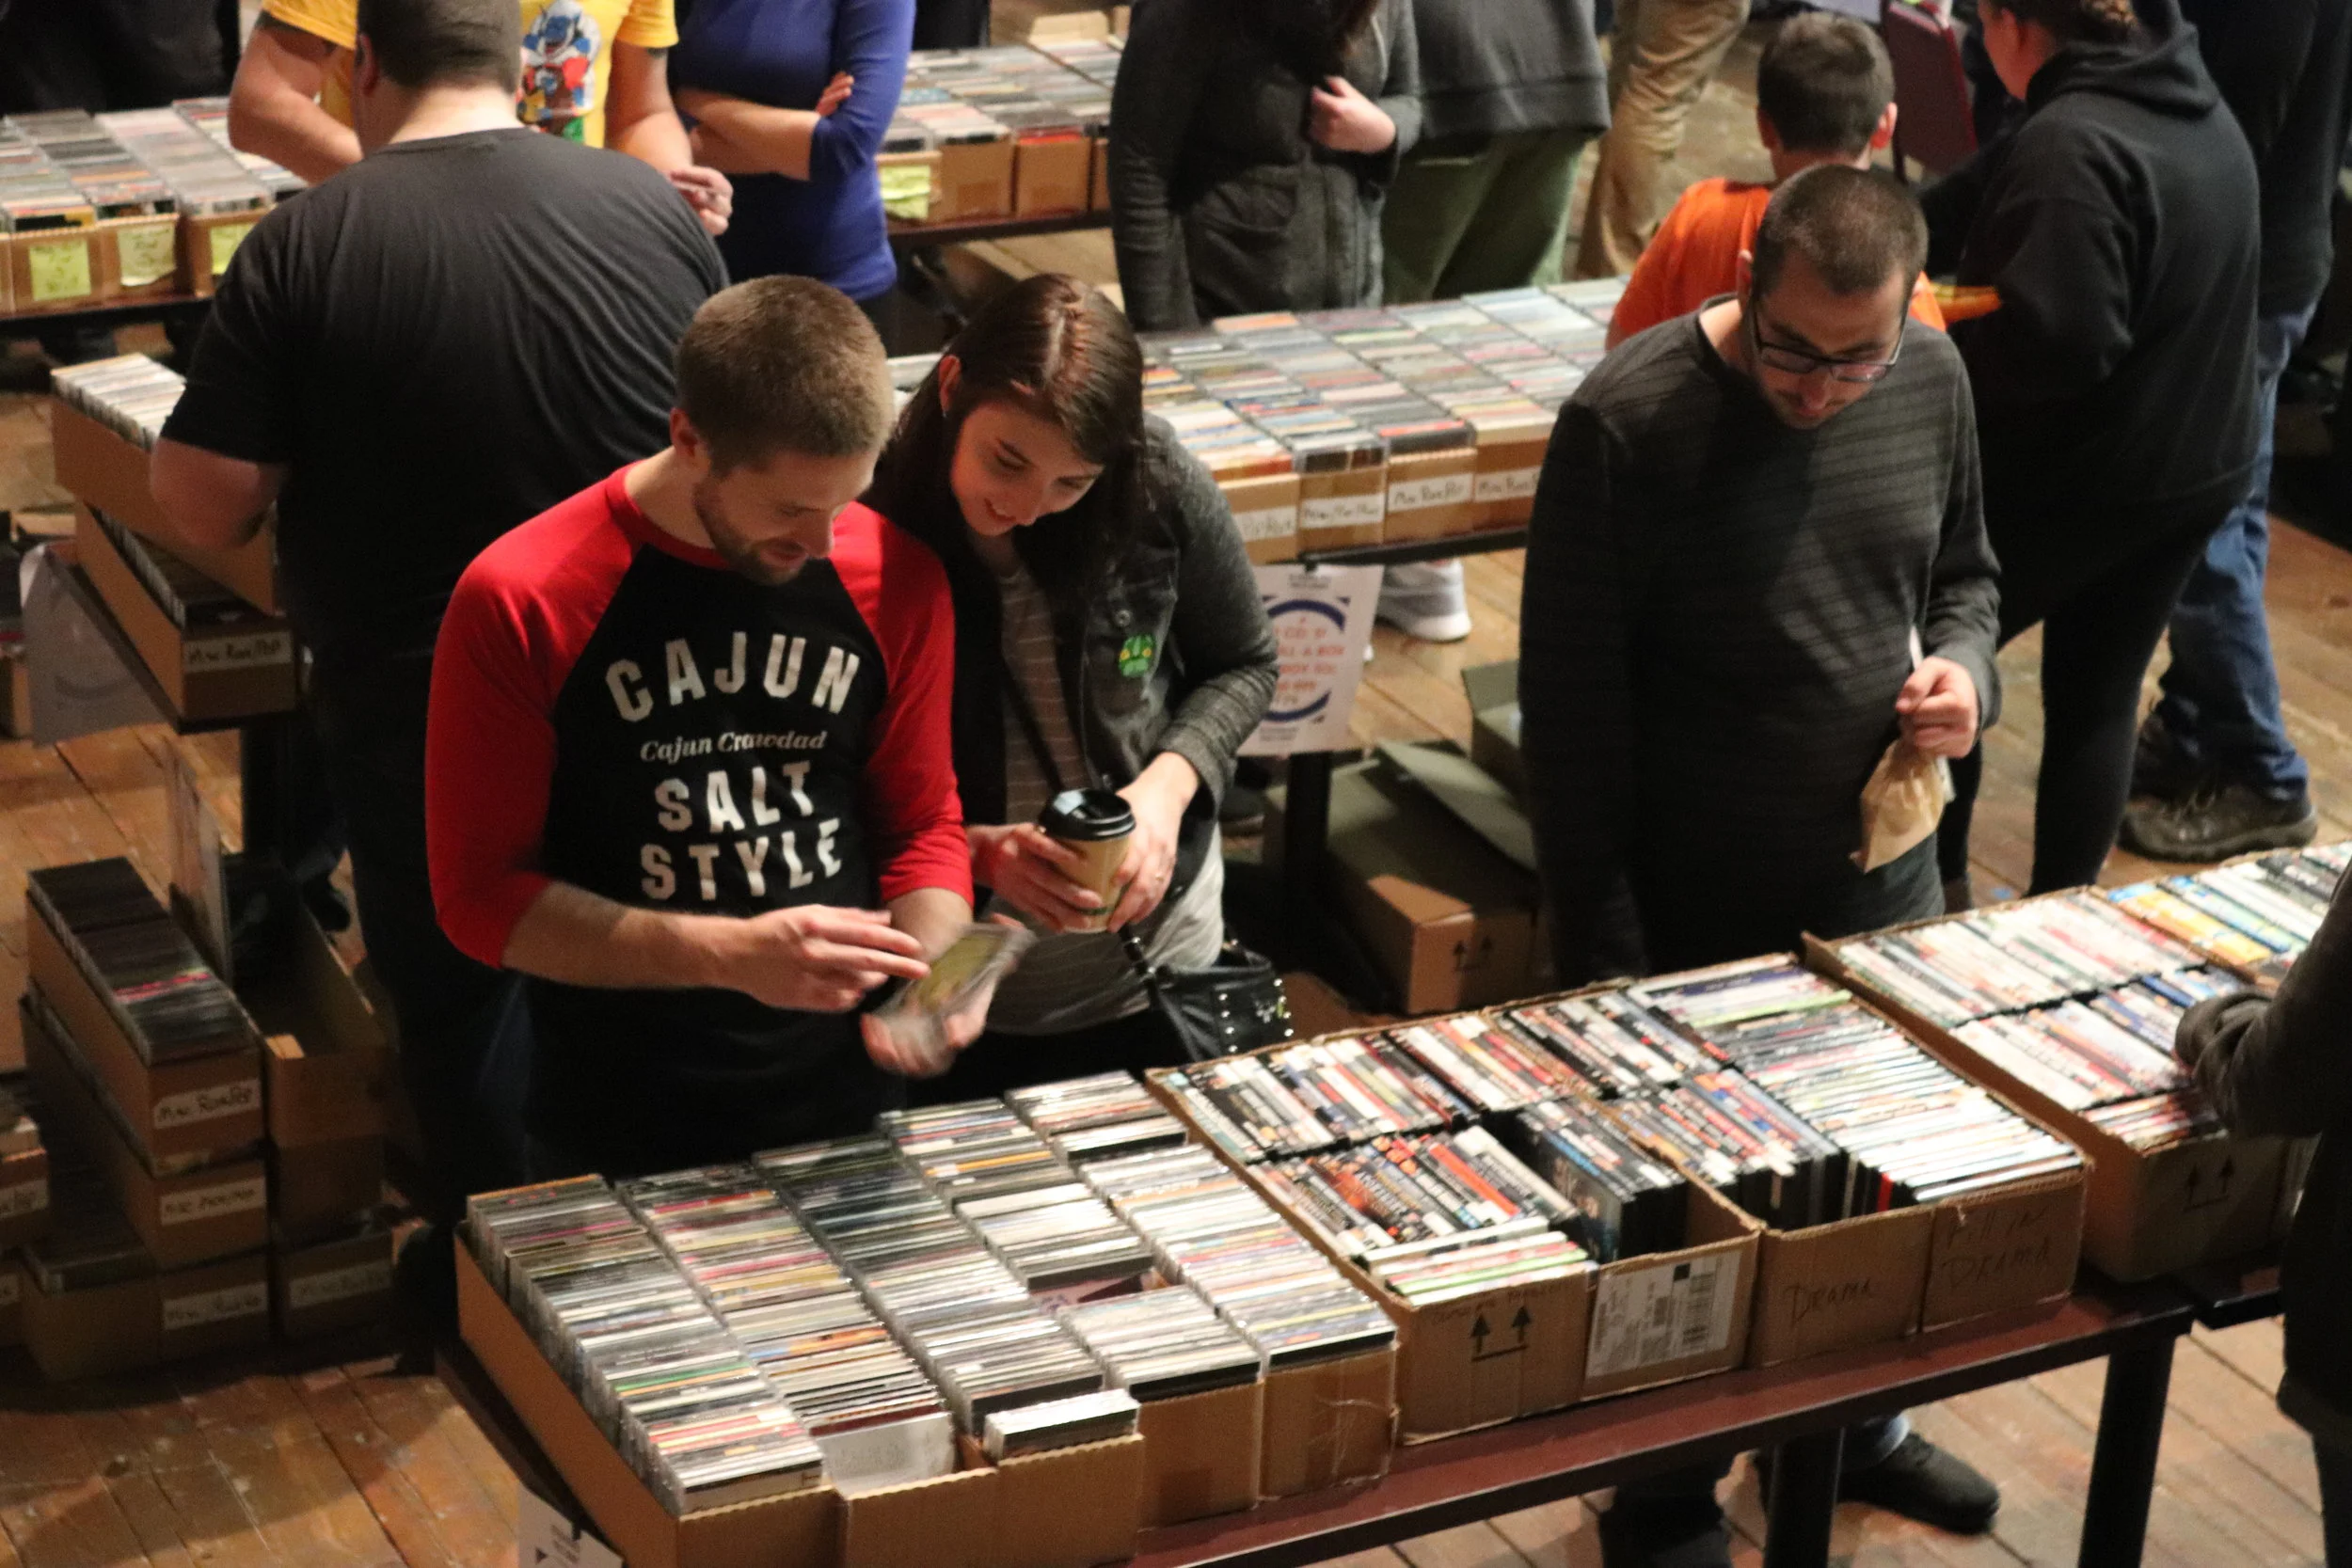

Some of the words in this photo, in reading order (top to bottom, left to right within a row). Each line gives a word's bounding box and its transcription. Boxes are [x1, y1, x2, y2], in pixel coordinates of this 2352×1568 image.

[605, 631, 860, 721] CAJUN
[640, 736, 712, 764] Cajun
[717, 731, 828, 752] Crawdad
[654, 760, 814, 833] SALT
[640, 817, 841, 900] STYLE
